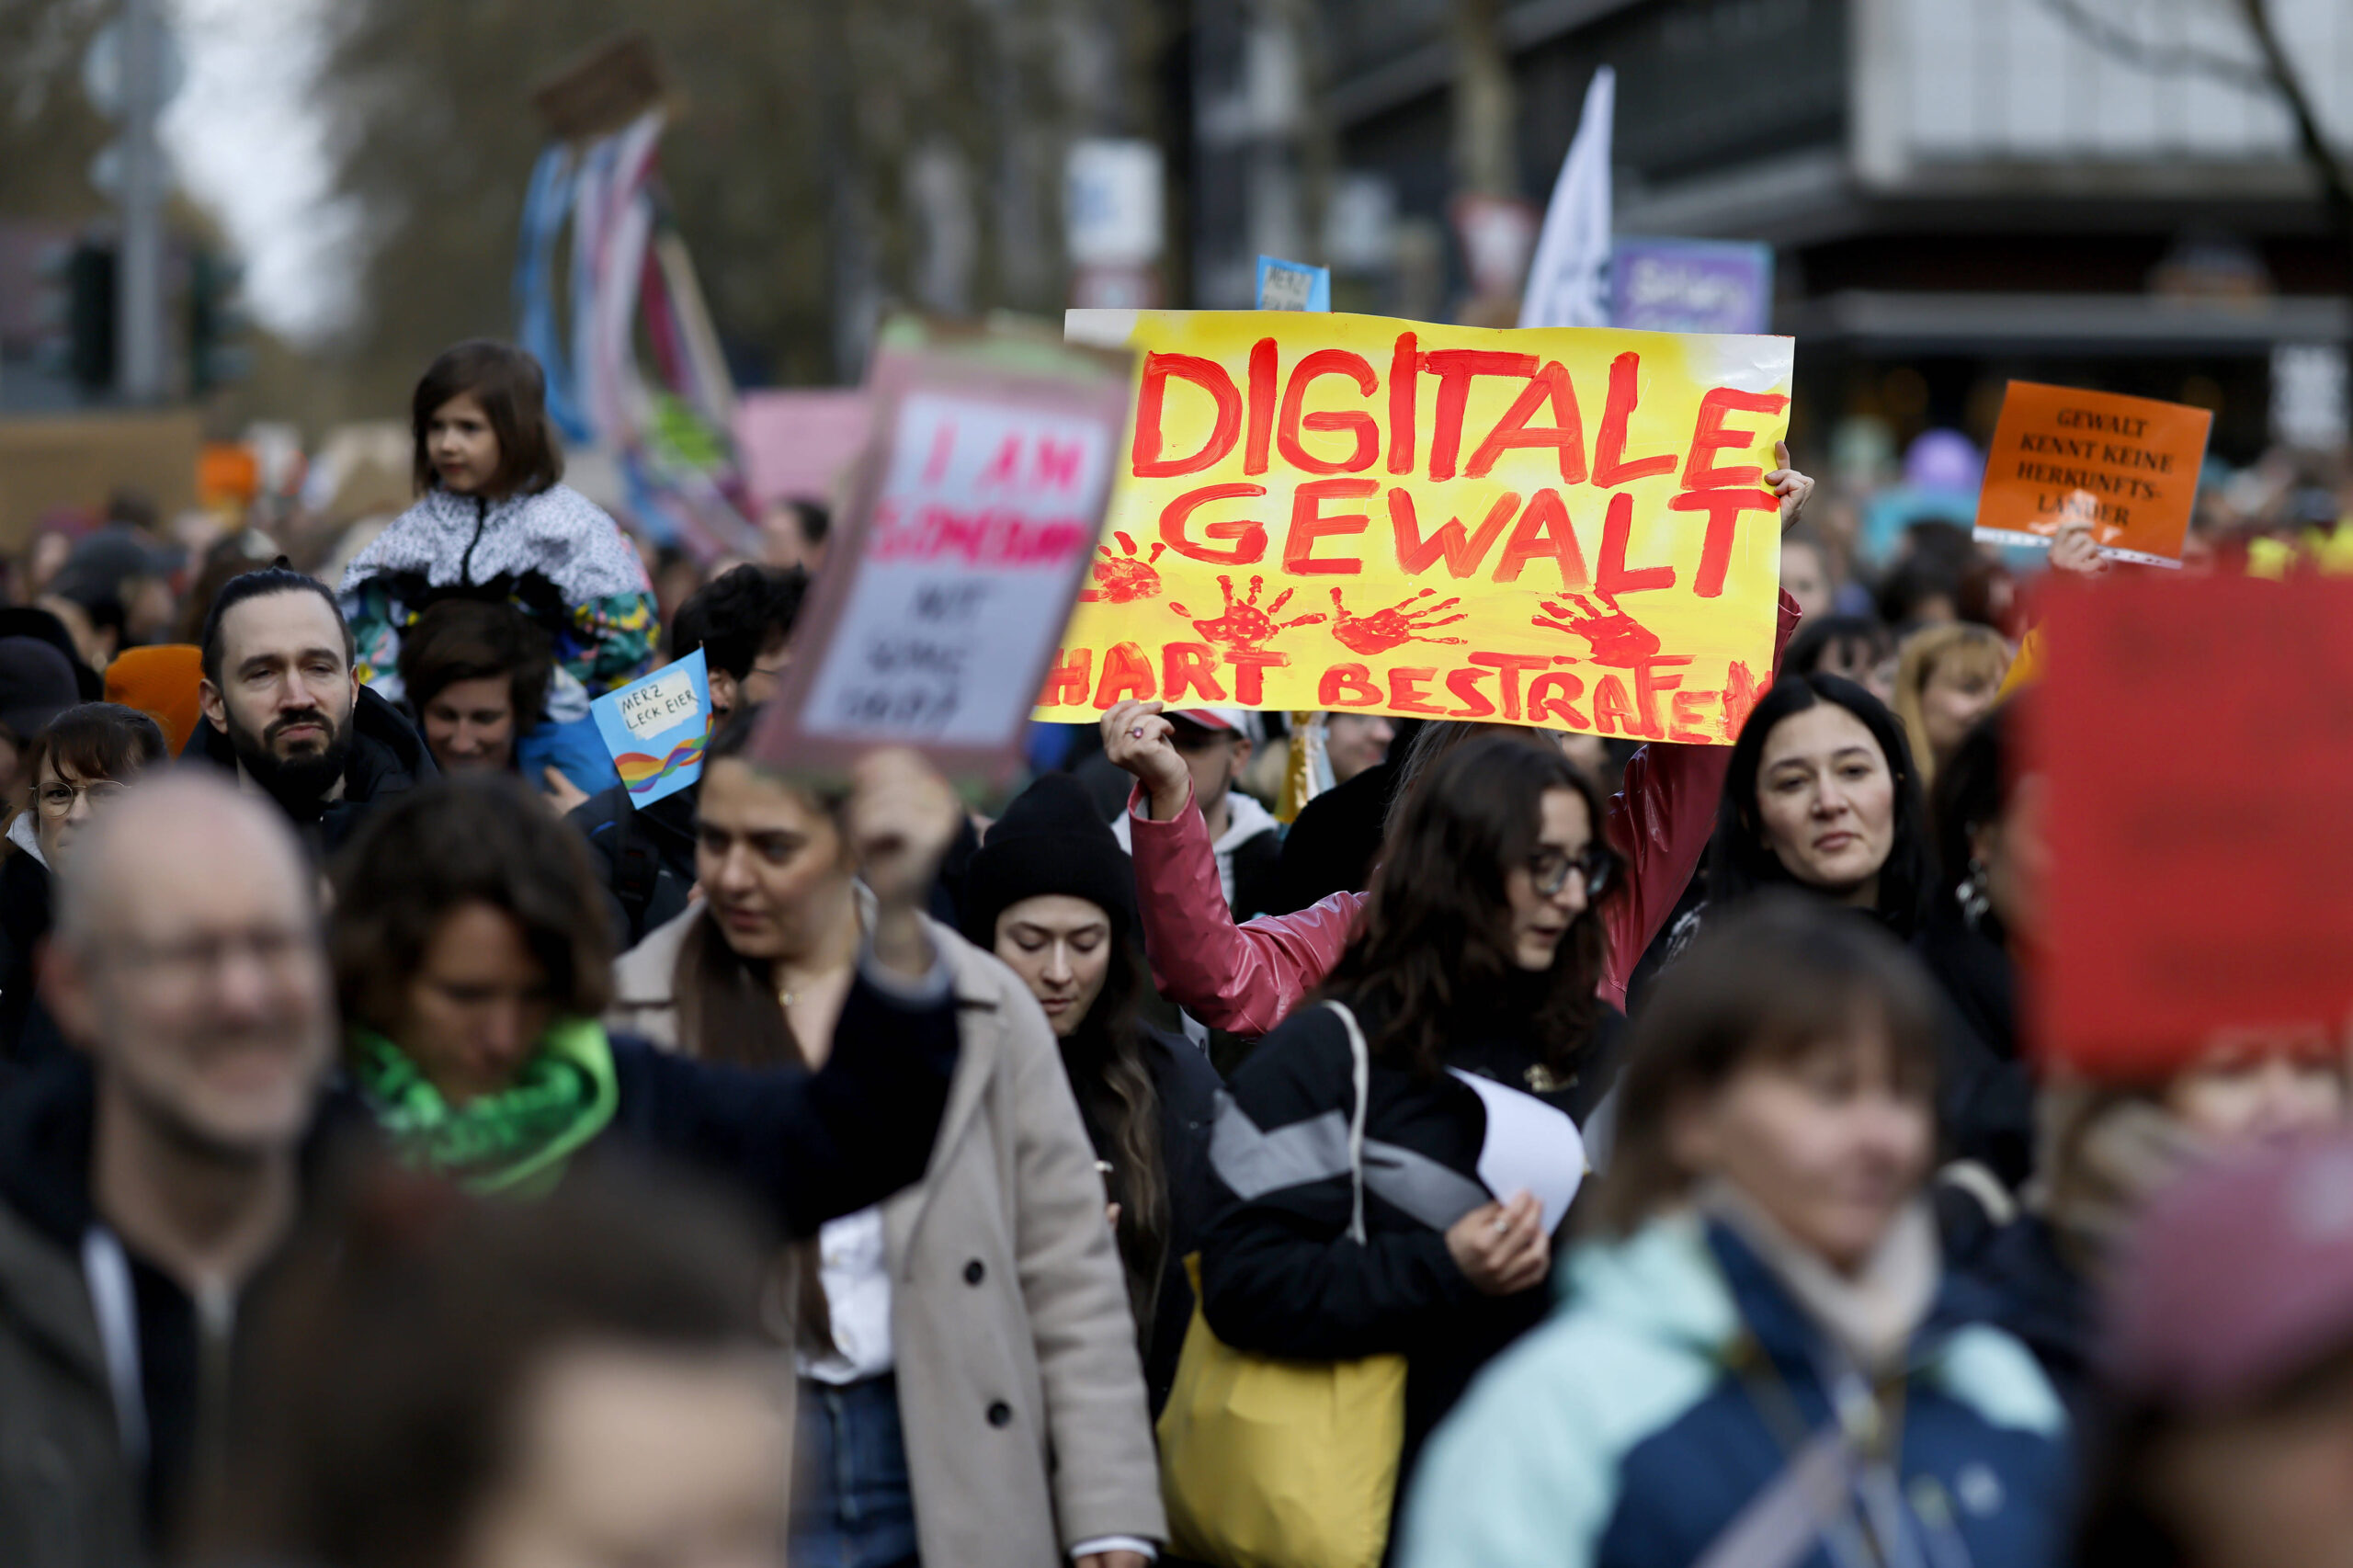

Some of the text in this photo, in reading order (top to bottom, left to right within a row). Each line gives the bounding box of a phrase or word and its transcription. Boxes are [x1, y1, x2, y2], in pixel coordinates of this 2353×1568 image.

[1131, 332, 1791, 491] DIGITALE
[2057, 407, 2149, 438] GEWALT
[2020, 432, 2176, 475] KENNT KEINE
[2017, 460, 2163, 501] HERKUNFTS-
[1159, 483, 1780, 597] GEWALT
[622, 684, 664, 714] MERZ
[626, 689, 700, 730] LECK EIER
[1035, 642, 1292, 710] HART
[1318, 651, 1773, 744] BESTRAFEN
